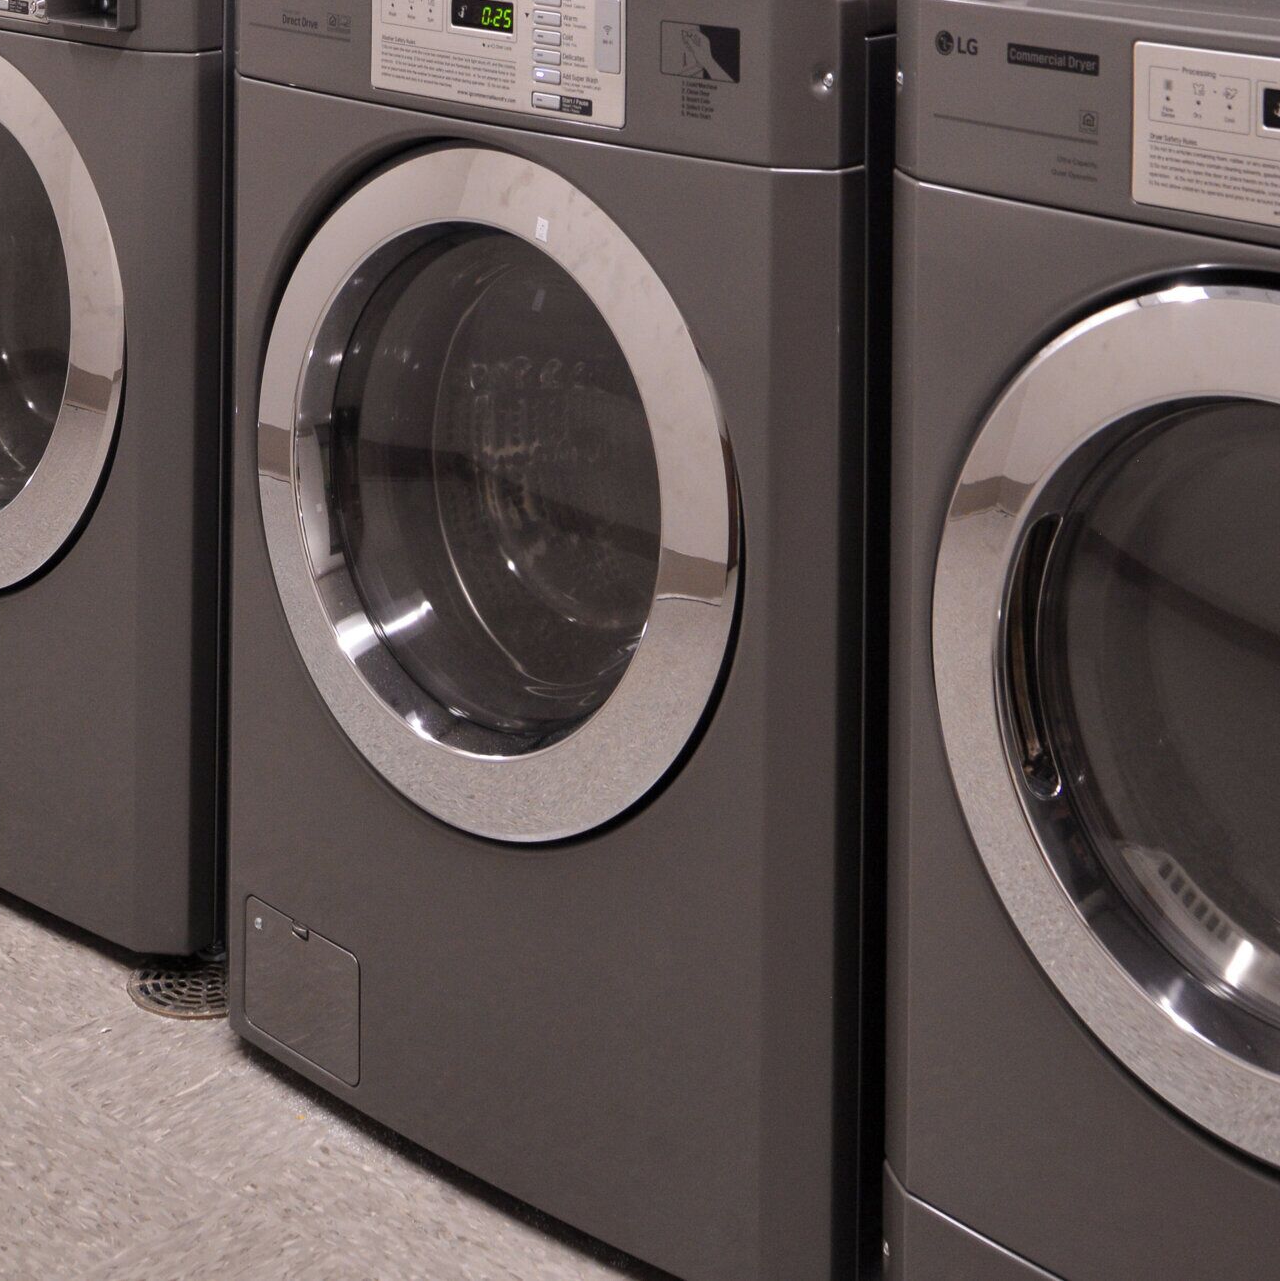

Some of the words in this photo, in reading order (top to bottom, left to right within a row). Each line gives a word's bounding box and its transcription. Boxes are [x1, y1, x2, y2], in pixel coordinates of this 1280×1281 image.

[282, 14, 300, 26] Direct
[301, 16, 318, 29] Drive
[957, 37, 978, 56] LG
[1009, 48, 1066, 67] Commercial
[1068, 56, 1097, 72] Dryer
[1181, 67, 1216, 79] Processing
